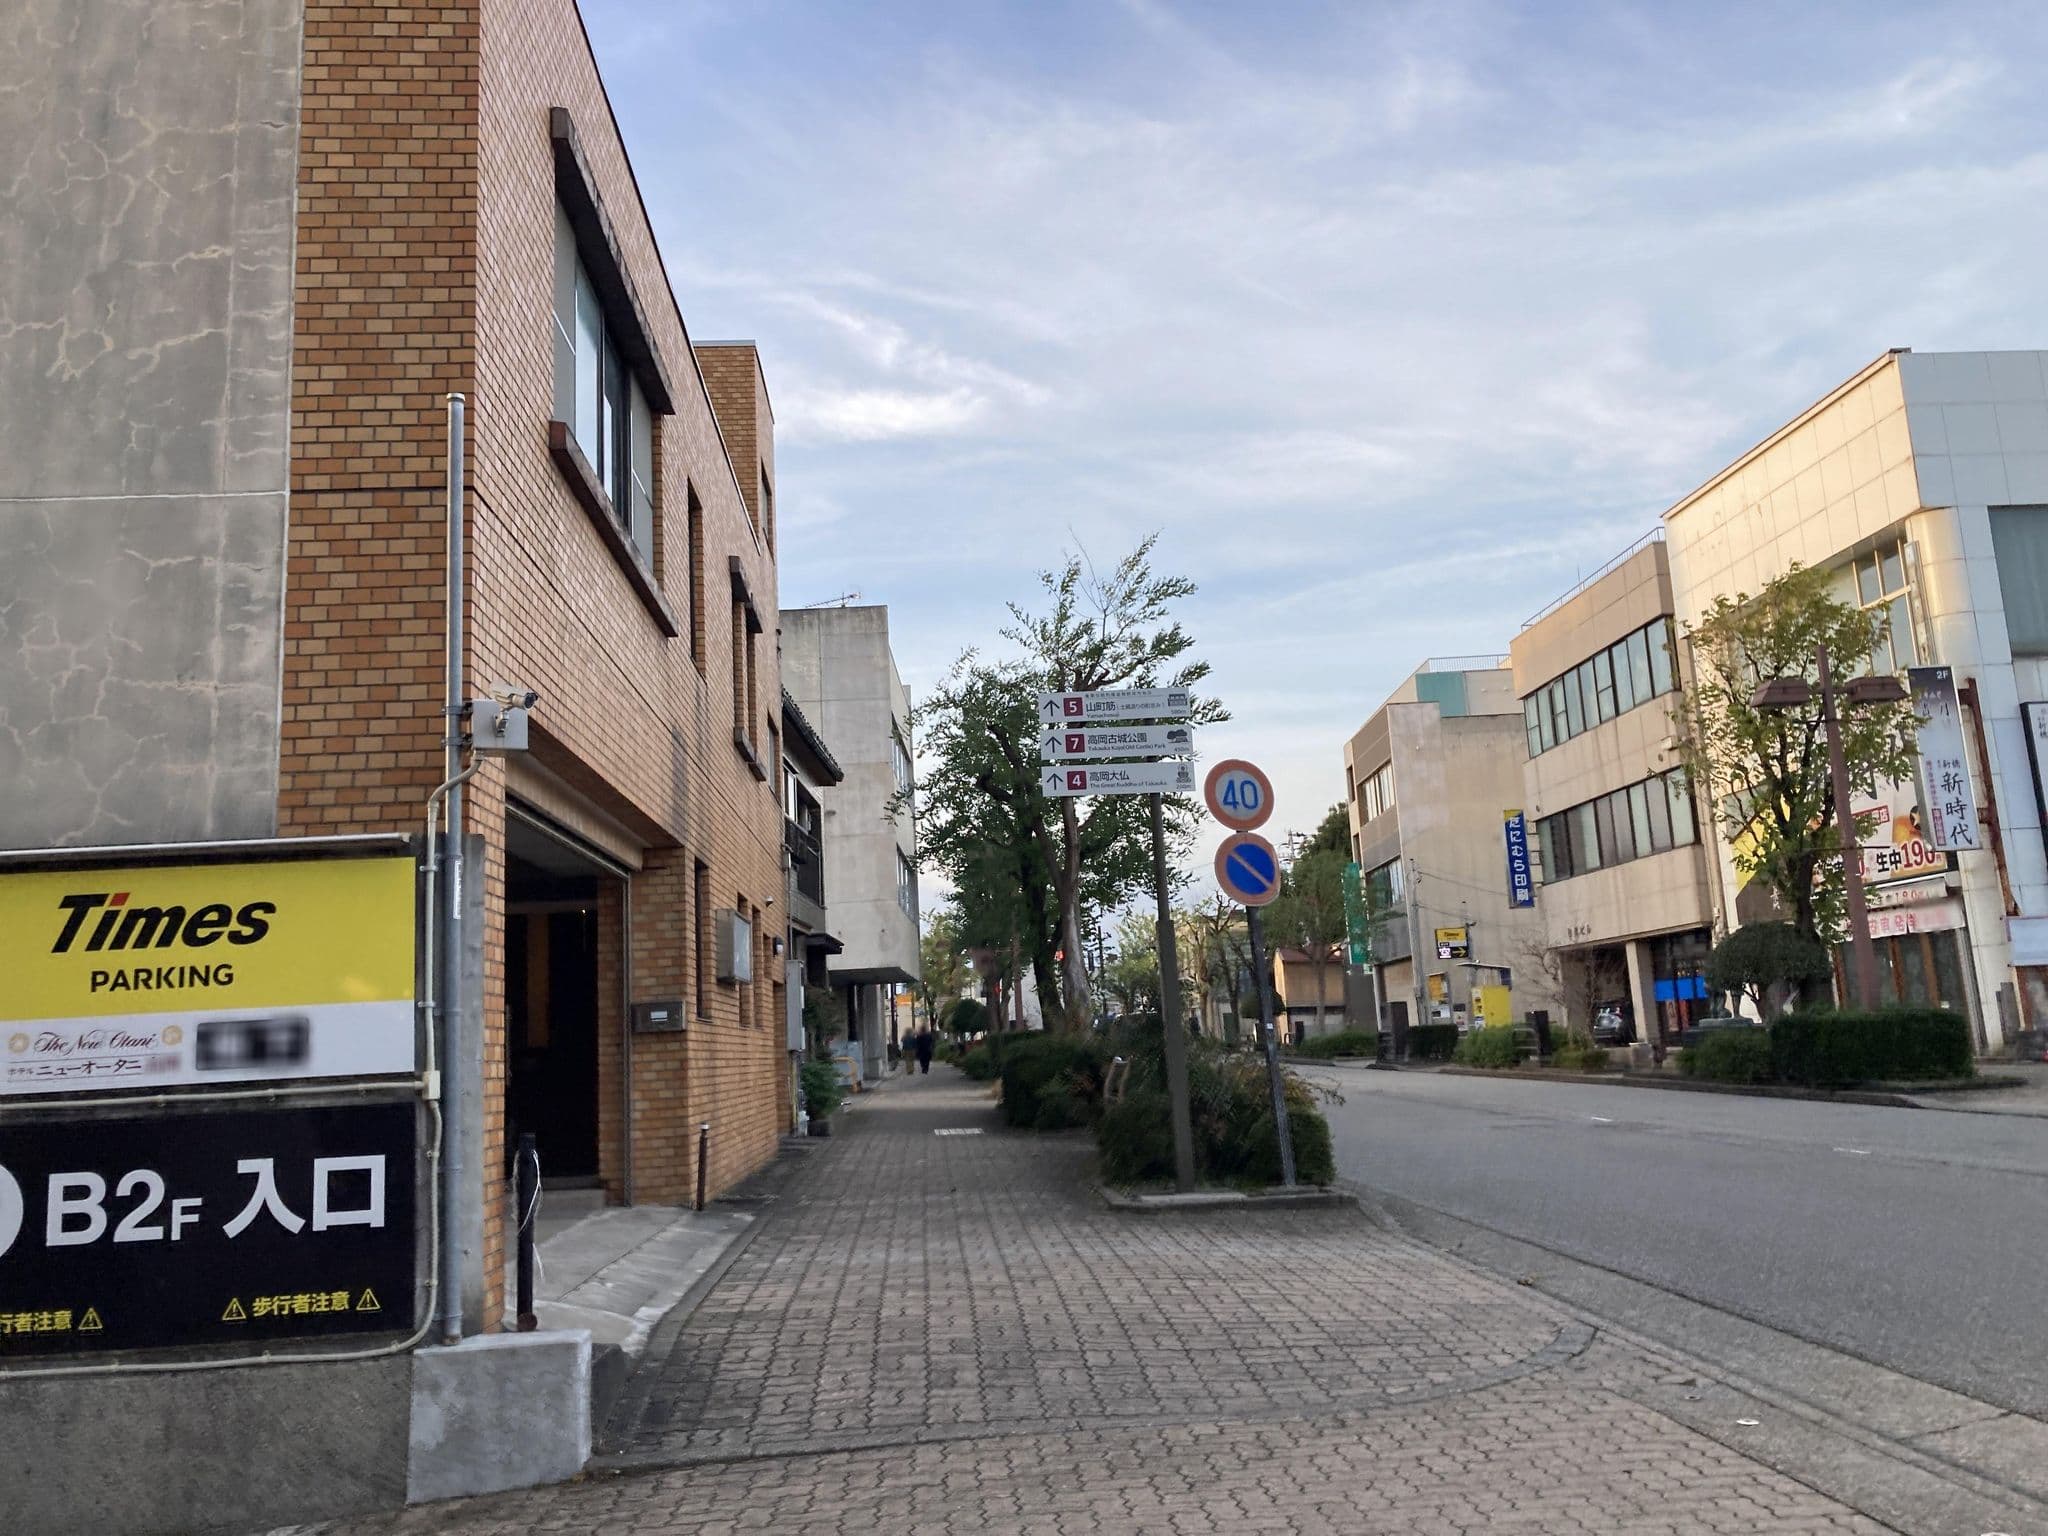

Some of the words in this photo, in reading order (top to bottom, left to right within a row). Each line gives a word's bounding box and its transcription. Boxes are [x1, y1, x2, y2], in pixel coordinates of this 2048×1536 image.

[1936, 670, 1949, 679] 2F
[1069, 700, 1078, 713] 5
[1085, 701, 1116, 712] 山町筋
[1070, 737, 1079, 749] 7
[1087, 732, 1148, 745] 高岡古城公園
[1072, 775, 1082, 787] 4
[1089, 770, 1130, 782] 高岡大仏
[1223, 779, 1259, 810] 40
[1941, 772, 1973, 850] 新時代
[51, 892, 277, 954] Times
[90, 963, 235, 993] PARKING
[34, 1032, 71, 1053] The
[63, 1030, 104, 1056] New
[109, 1030, 158, 1050] Otani
[36, 1058, 142, 1077] ニューオータニ
[46, 1168, 203, 1247] B2F
[222, 1154, 386, 1239] 入口
[252, 1291, 350, 1317] 歩行者注意
